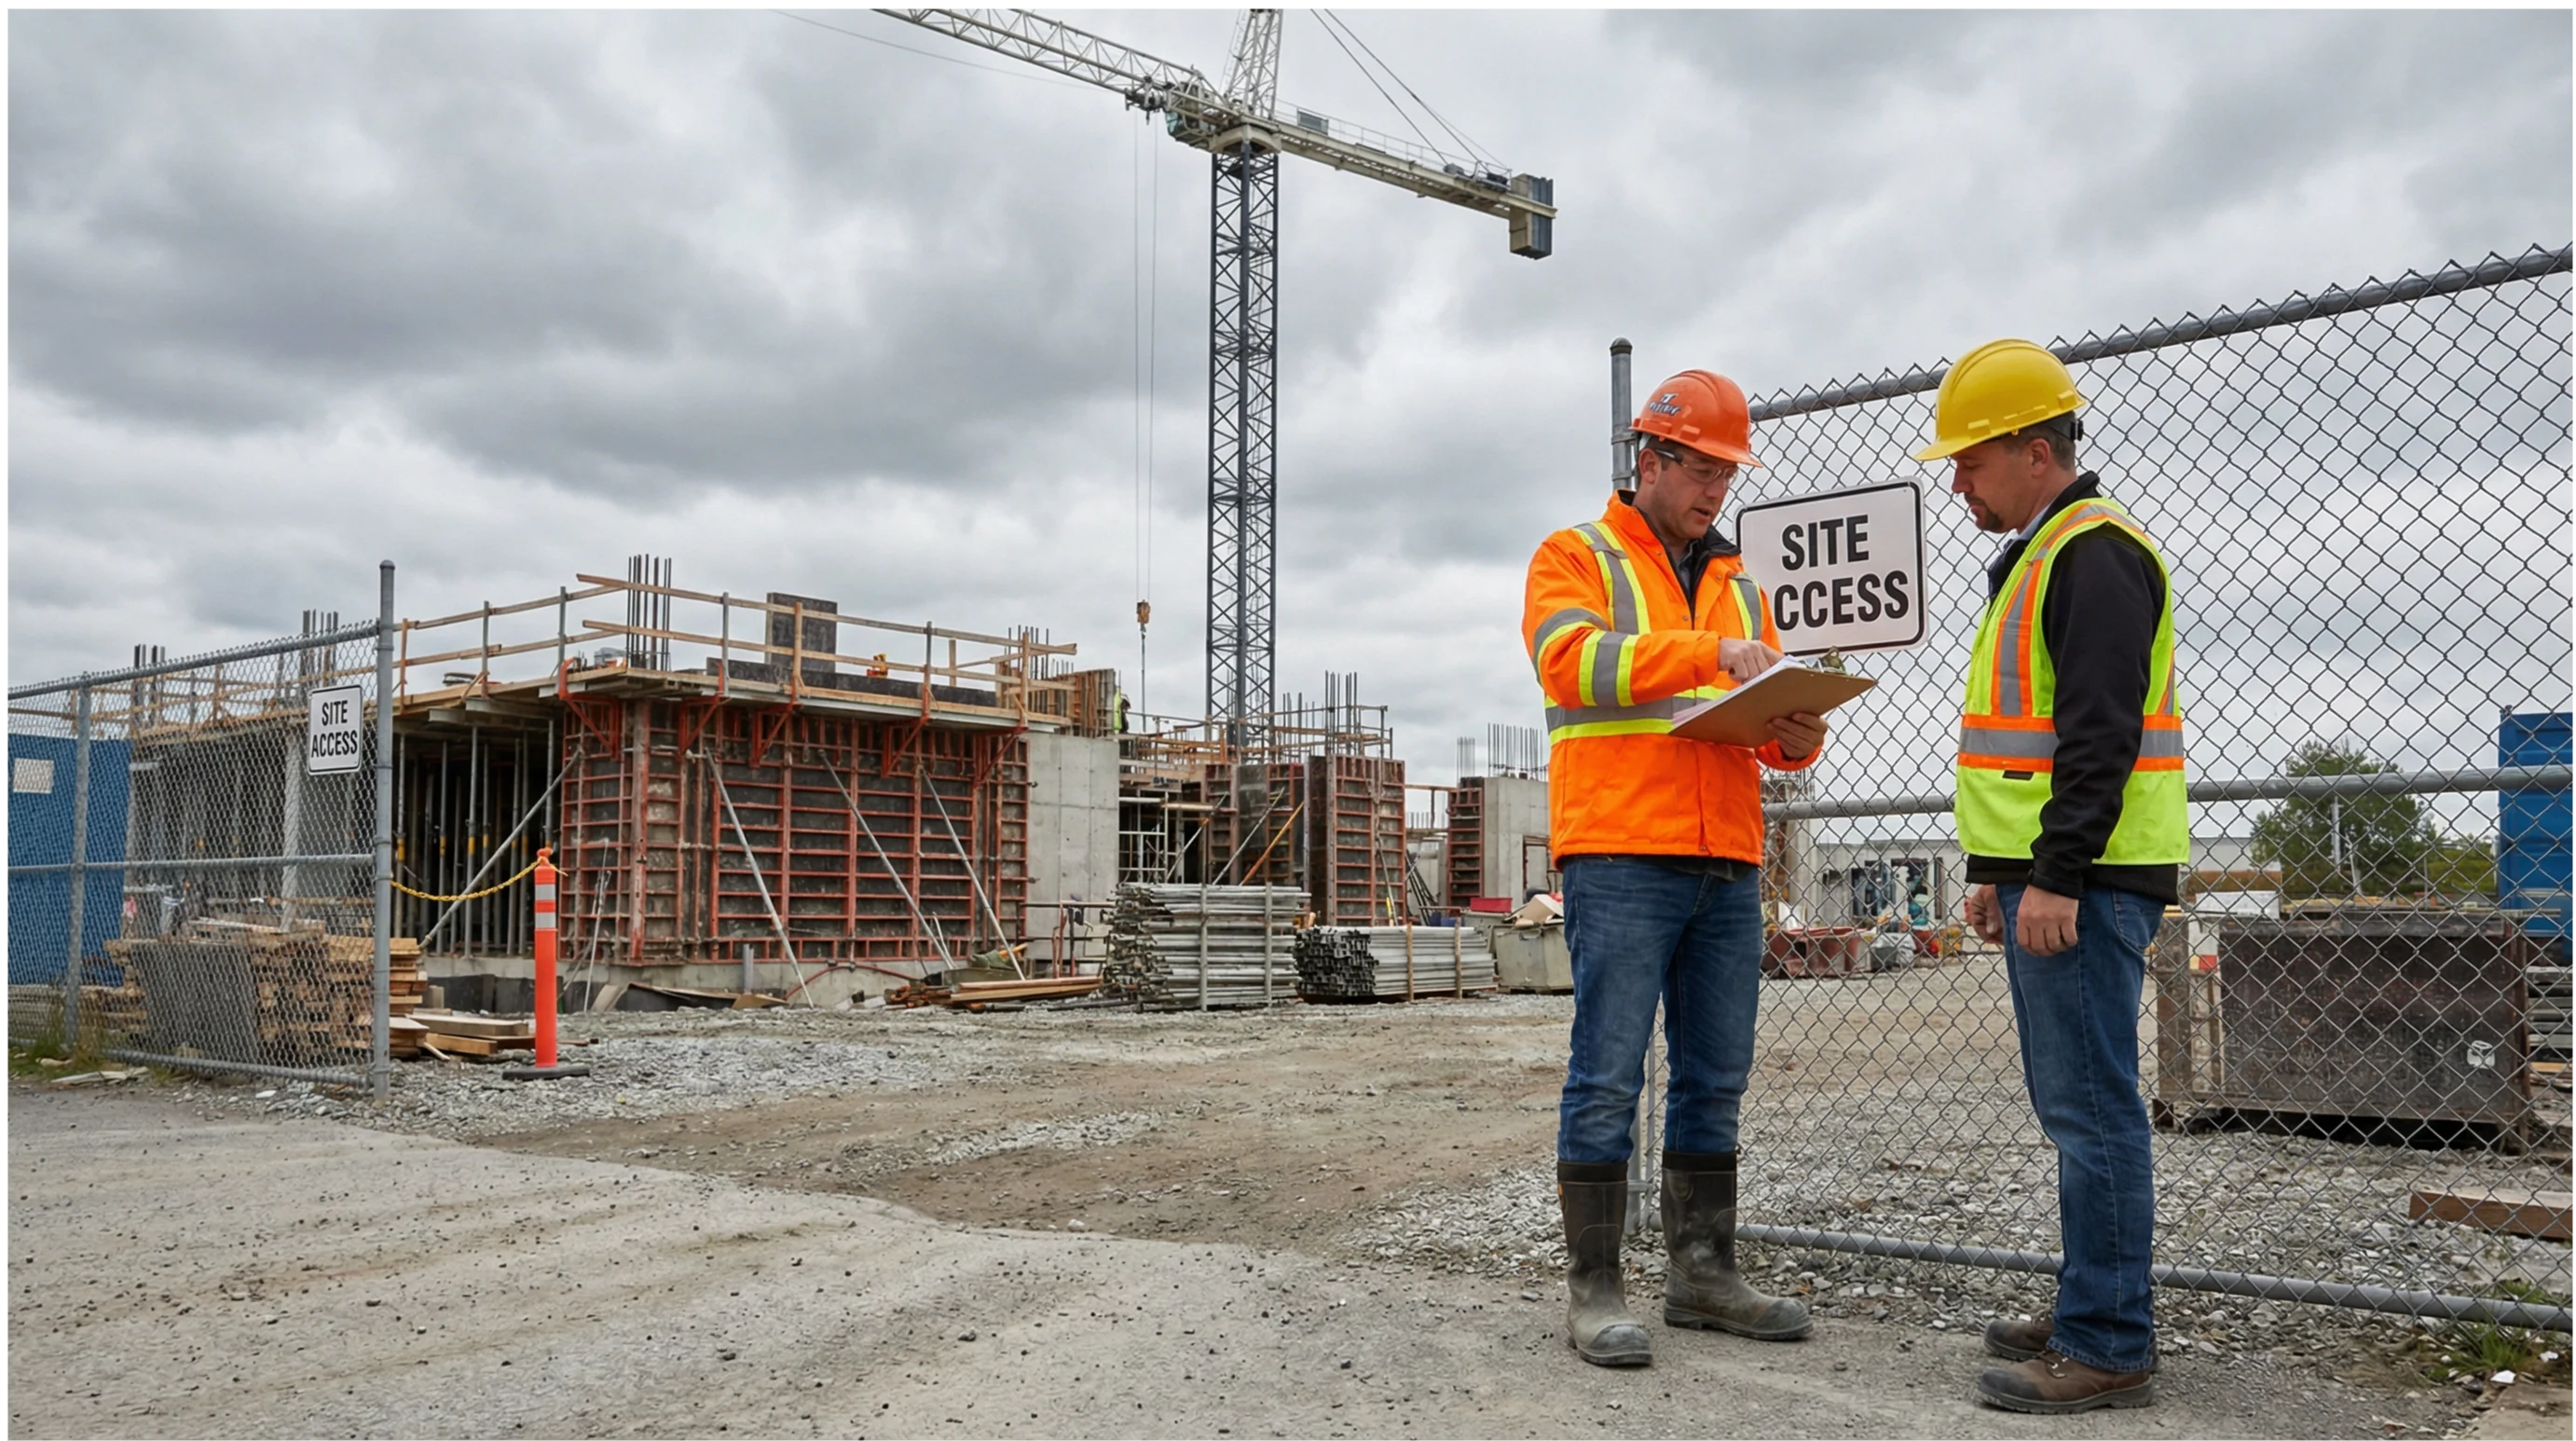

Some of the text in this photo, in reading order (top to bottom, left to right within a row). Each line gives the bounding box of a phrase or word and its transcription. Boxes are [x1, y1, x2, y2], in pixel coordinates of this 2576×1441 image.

[1781, 514, 1870, 571] SITE
[1774, 570, 1910, 631] CCESS
[322, 700, 348, 726] SITE
[311, 730, 358, 758] ACCESS
